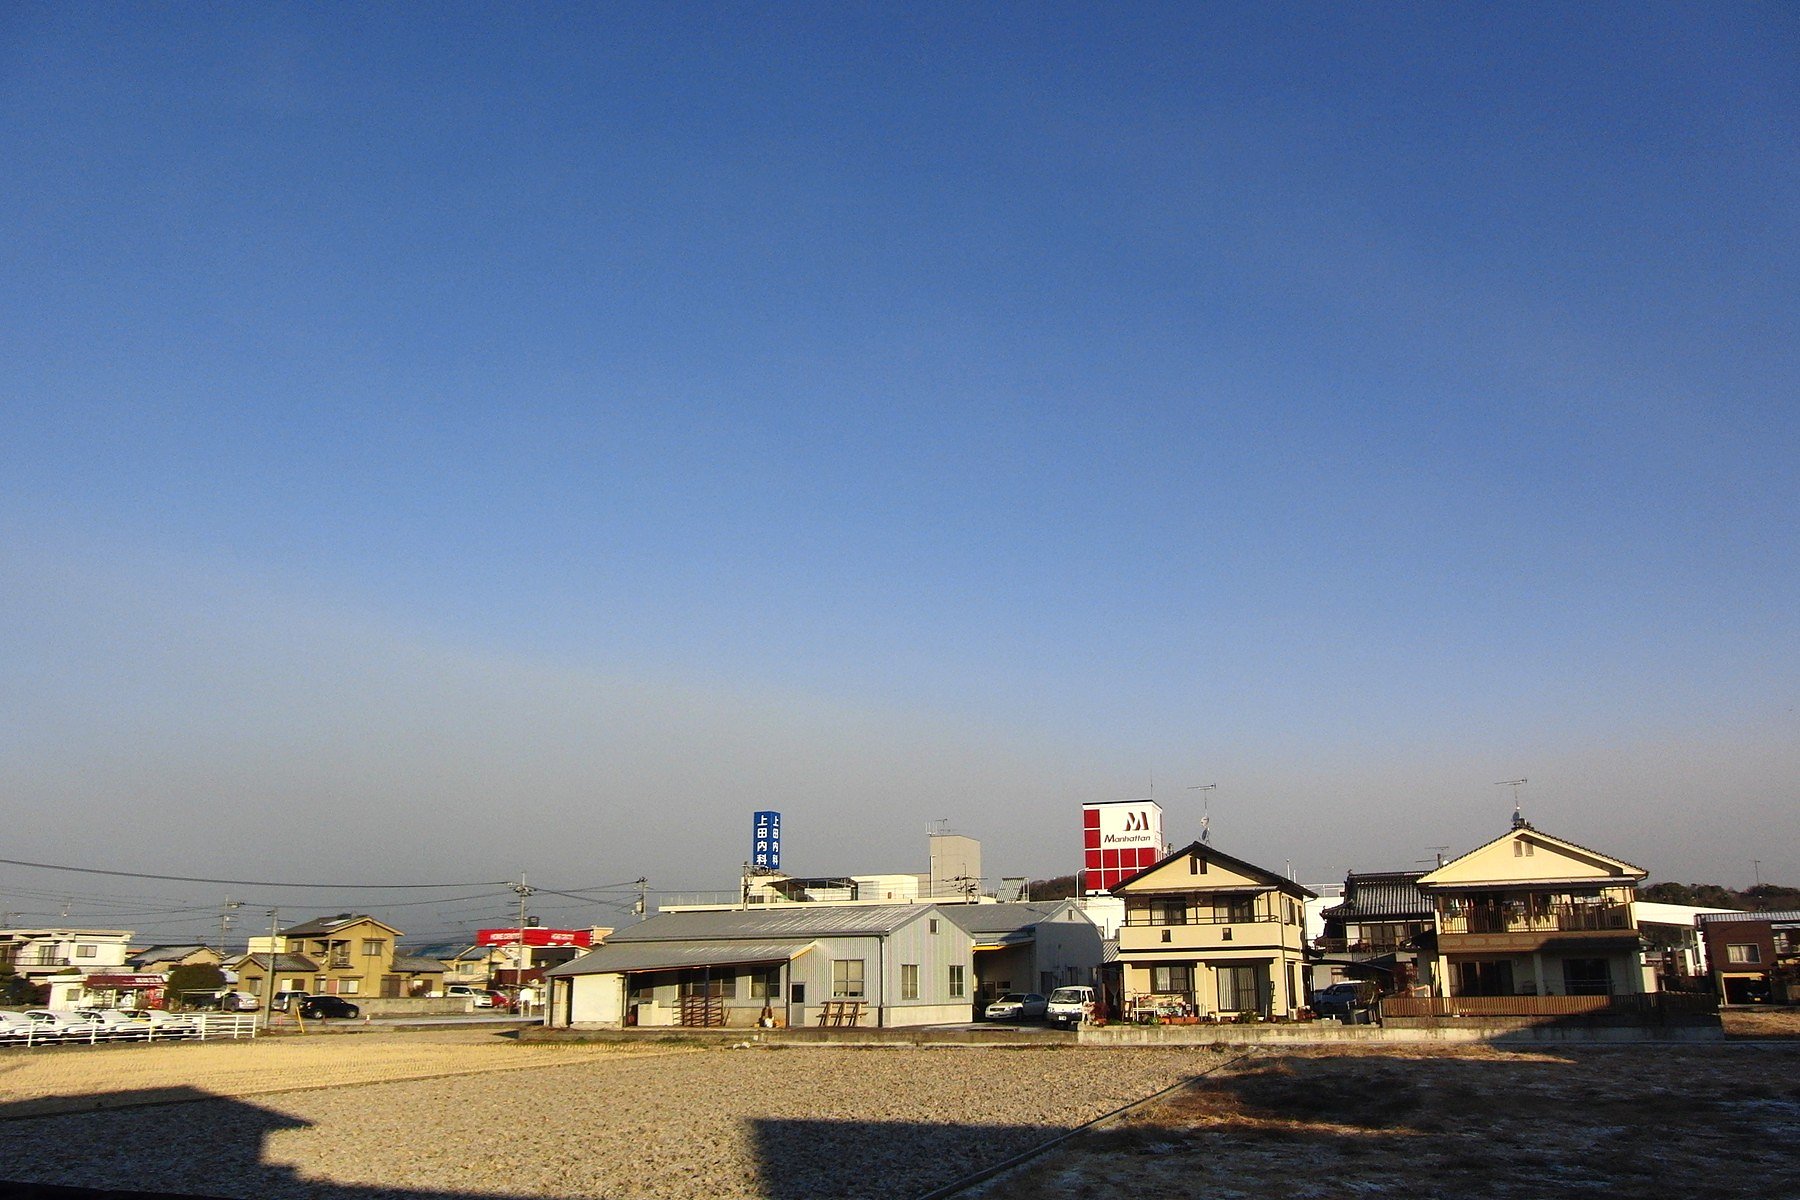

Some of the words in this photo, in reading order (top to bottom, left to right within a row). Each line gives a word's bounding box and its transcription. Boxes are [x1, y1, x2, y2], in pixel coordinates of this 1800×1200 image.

[757, 815, 768, 865] 上田内科
[1104, 834, 1151, 843] Manhattan
